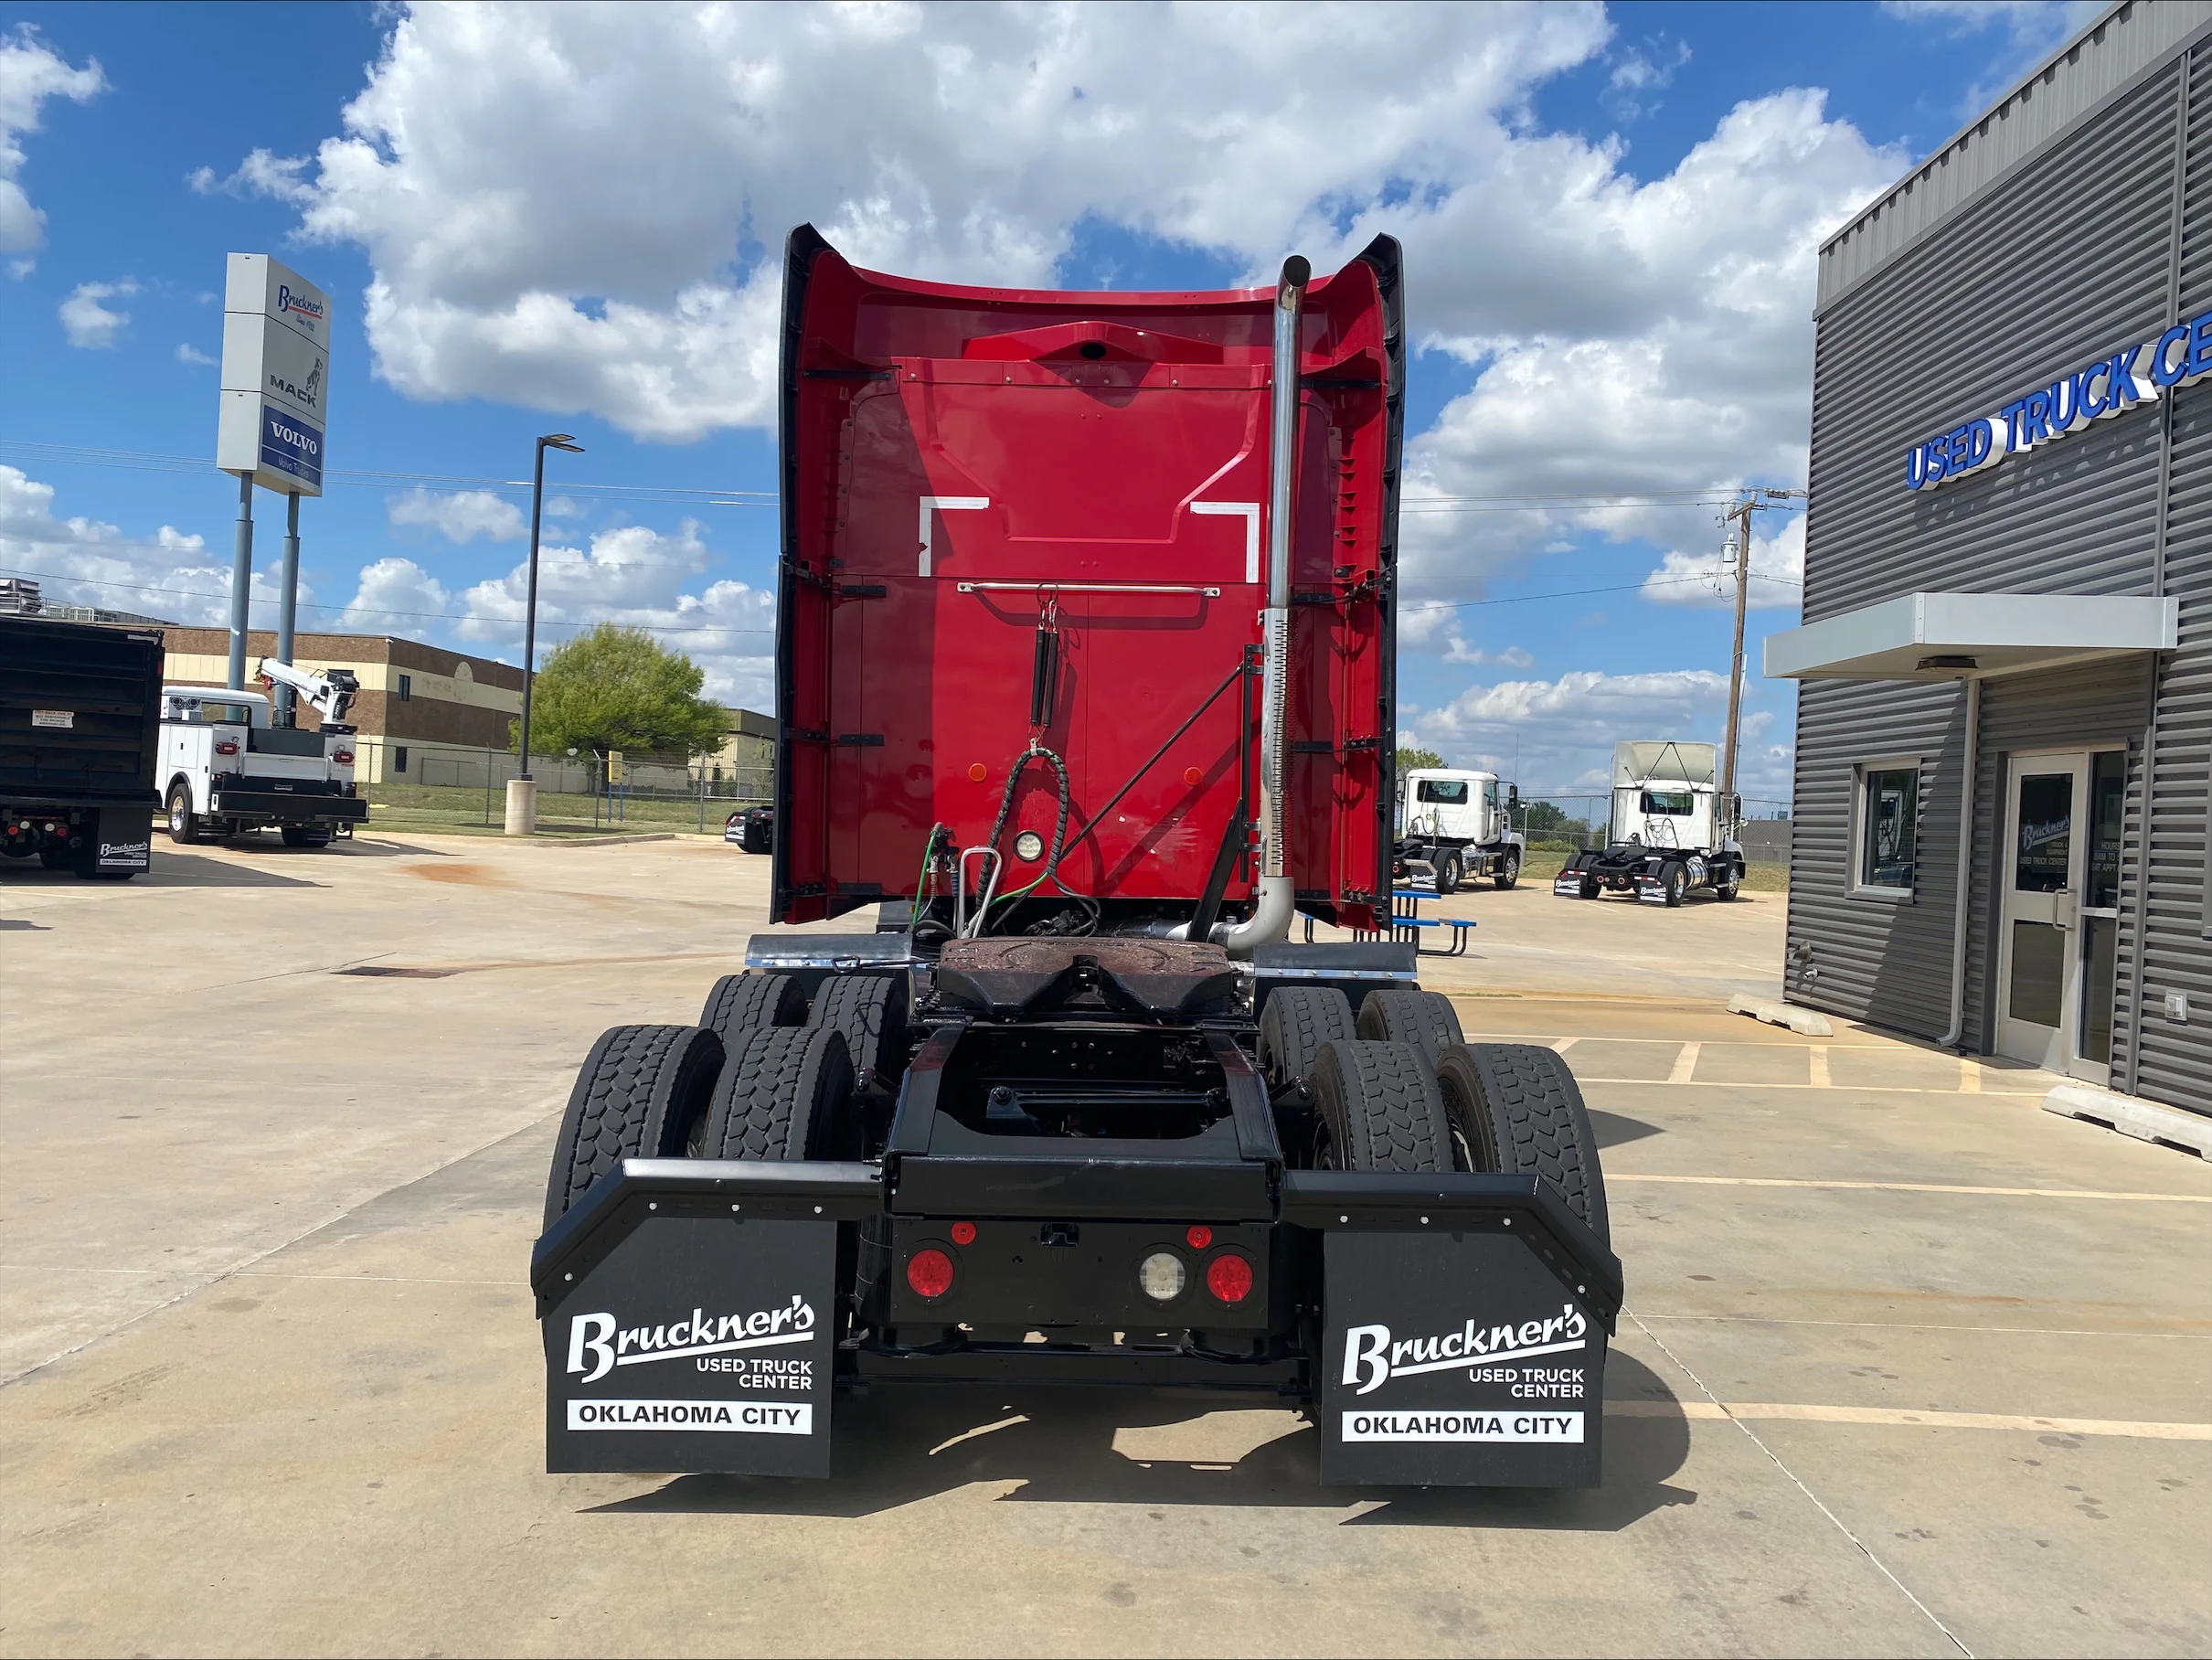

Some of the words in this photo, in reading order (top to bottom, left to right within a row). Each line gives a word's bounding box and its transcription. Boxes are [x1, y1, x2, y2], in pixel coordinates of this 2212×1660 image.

[278, 284, 324, 315] Bruckner's
[270, 374, 317, 409] MACK
[1907, 418, 1994, 491] USED
[2001, 344, 2143, 453] TRUCK
[271, 420, 318, 455] VOLVO
[2022, 814, 2070, 851] Bruckner's
[101, 841, 148, 857] Bruckner's
[2100, 841, 2121, 851] HOURS
[2033, 857, 2048, 866] TRUCK
[2107, 852, 2116, 862] TO
[2090, 862, 2101, 871] SAT
[567, 1294, 815, 1384] Bruckner's
[1342, 1304, 1587, 1396] Bruckner's
[697, 1358, 746, 1373] USED
[750, 1358, 813, 1375] TRUCK
[1469, 1368, 1518, 1383] USED
[1522, 1368, 1584, 1383] TRUCK
[739, 1374, 813, 1390] CENTER
[1511, 1384, 1584, 1399] CENTER
[579, 1405, 732, 1424] OKLAHOMA
[742, 1408, 801, 1426] CITY
[1353, 1416, 1504, 1435] OKLAHOMA
[1514, 1417, 1572, 1435] CITY
